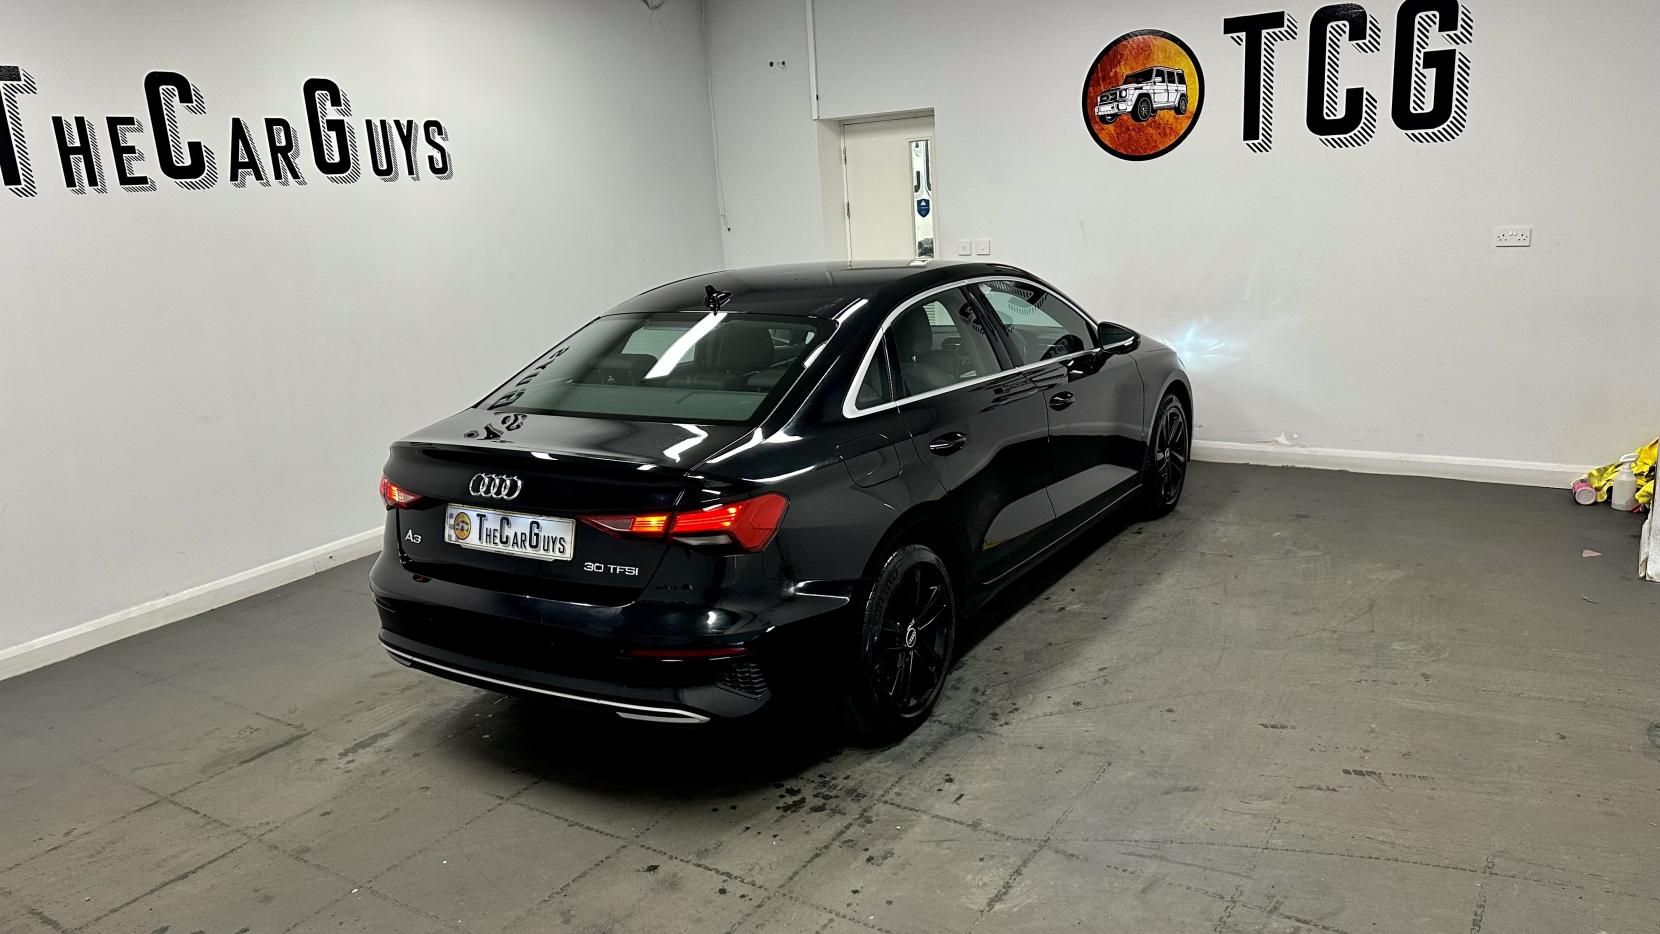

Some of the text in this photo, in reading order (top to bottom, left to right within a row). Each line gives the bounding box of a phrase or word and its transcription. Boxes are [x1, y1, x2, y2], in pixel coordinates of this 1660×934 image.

[1223, 0, 1473, 154] TCG
[405, 529, 422, 544] A3
[583, 562, 639, 576] 30 TFSI
